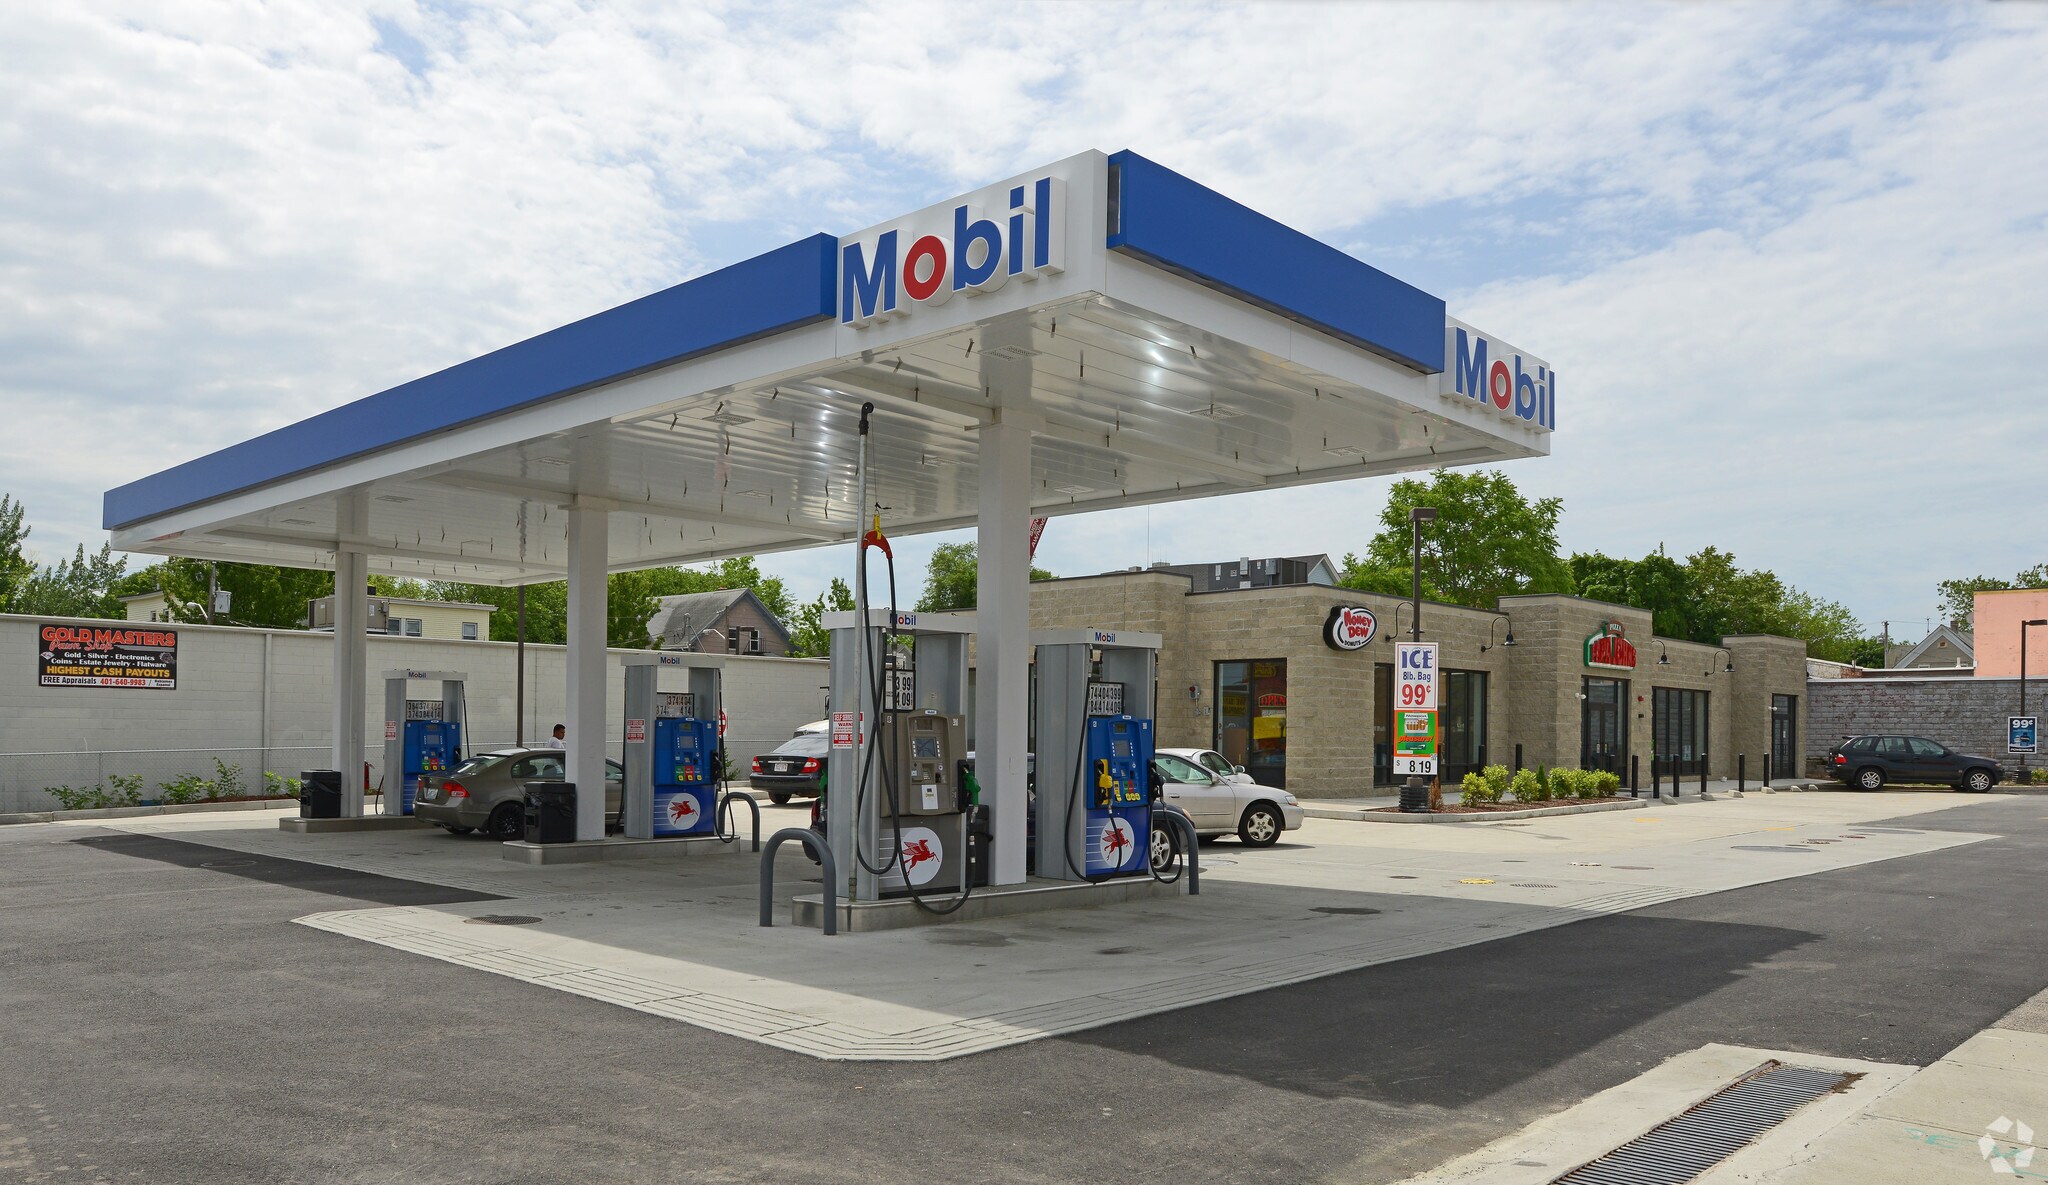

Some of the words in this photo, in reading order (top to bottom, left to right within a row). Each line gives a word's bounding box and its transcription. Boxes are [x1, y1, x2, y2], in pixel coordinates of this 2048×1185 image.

[841, 176, 1053, 325] Mobil
[1455, 327, 1555, 432] Mobil
[41, 626, 92, 642] GOLD
[95, 629, 175, 647] MASTERS
[1094, 632, 1116, 642] Mobil
[49, 639, 81, 651] Pawn
[84, 639, 114, 652] Shop
[64, 651, 81, 659] Gold
[115, 653, 155, 661] Electronics
[660, 656, 680, 665] Mobil
[1401, 647, 1433, 669] ICE
[51, 657, 73, 665] Coins
[79, 658, 102, 666] Estate
[103, 659, 131, 667] Jewelry
[46, 665, 90, 675] HIGHEST
[93, 667, 123, 676] CASH
[125, 668, 170, 677] PAYOUTS
[1402, 671, 1416, 680] 8lb.
[1418, 671, 1431, 682] Bag
[43, 676, 60, 684] FREE
[62, 676, 97, 685] Appraisals
[100, 677, 146, 686] 401-640-9983
[1261, 695, 1287, 706] OPEN
[2012, 719, 2034, 728] 99¢
[1409, 760, 1432, 773] 8.19
